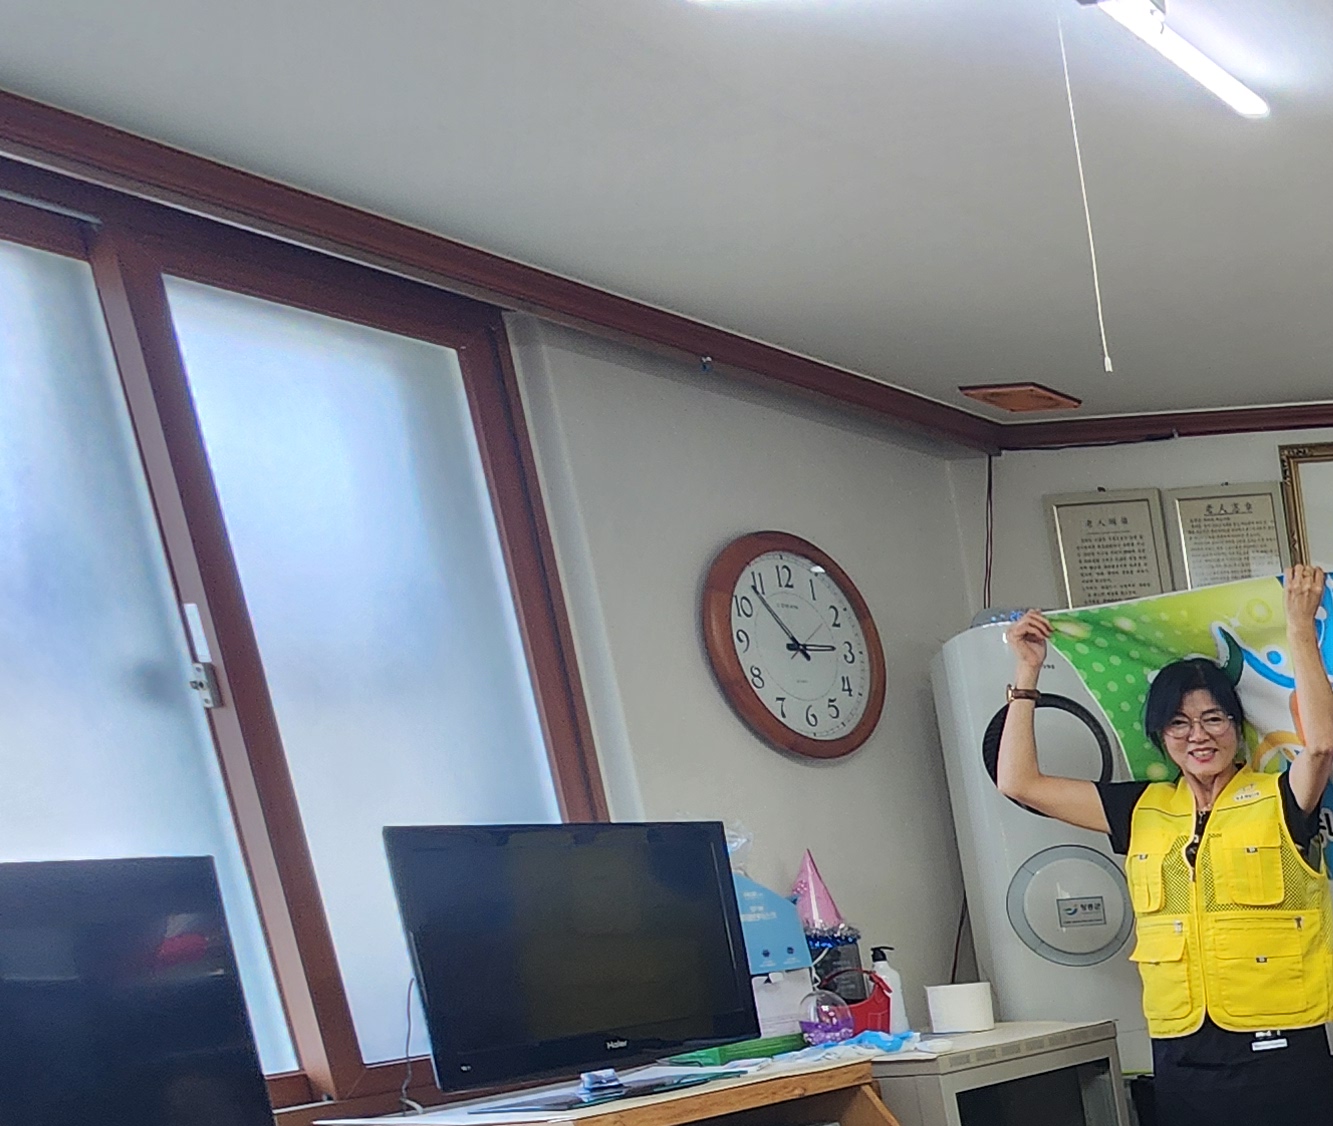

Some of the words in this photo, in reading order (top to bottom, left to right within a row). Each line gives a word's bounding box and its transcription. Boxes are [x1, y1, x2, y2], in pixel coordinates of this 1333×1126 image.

[751, 571, 766, 595] 11
[776, 564, 794, 589] 12
[809, 579, 817, 601] 1
[734, 594, 753, 618] 10
[829, 605, 841, 628] 2
[736, 629, 750, 653] 9
[843, 641, 856, 664] 3
[750, 666, 764, 689] 8
[841, 675, 853, 697] 4
[776, 697, 787, 718] 7
[805, 704, 818, 727] 6
[828, 698, 840, 719] 5
